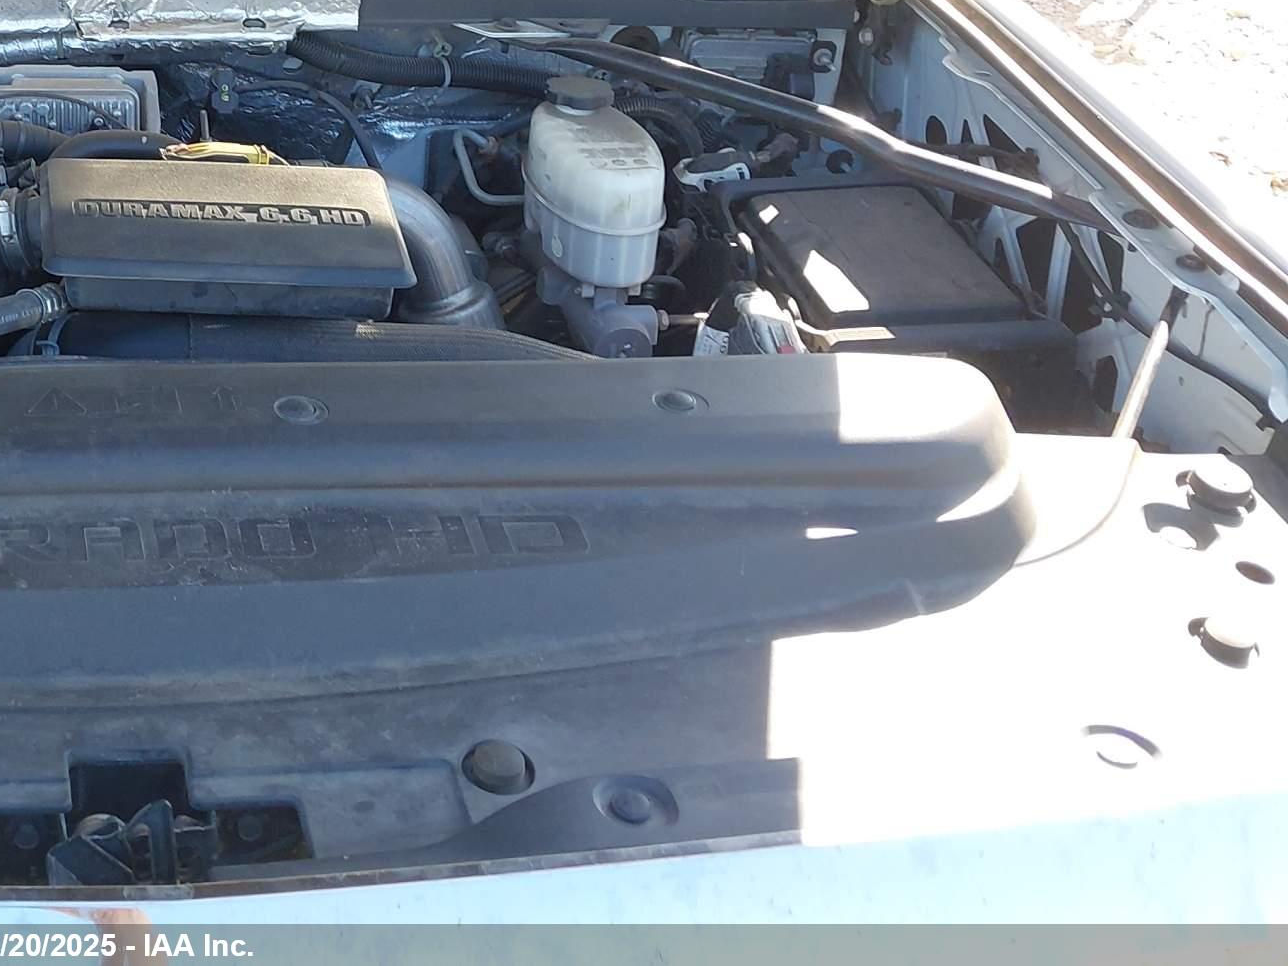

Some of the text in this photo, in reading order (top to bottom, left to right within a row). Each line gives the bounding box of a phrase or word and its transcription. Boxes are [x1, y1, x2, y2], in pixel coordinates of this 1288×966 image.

[78, 201, 364, 227] DURAMAX 6.6 HD
[362, 513, 591, 558] HD
